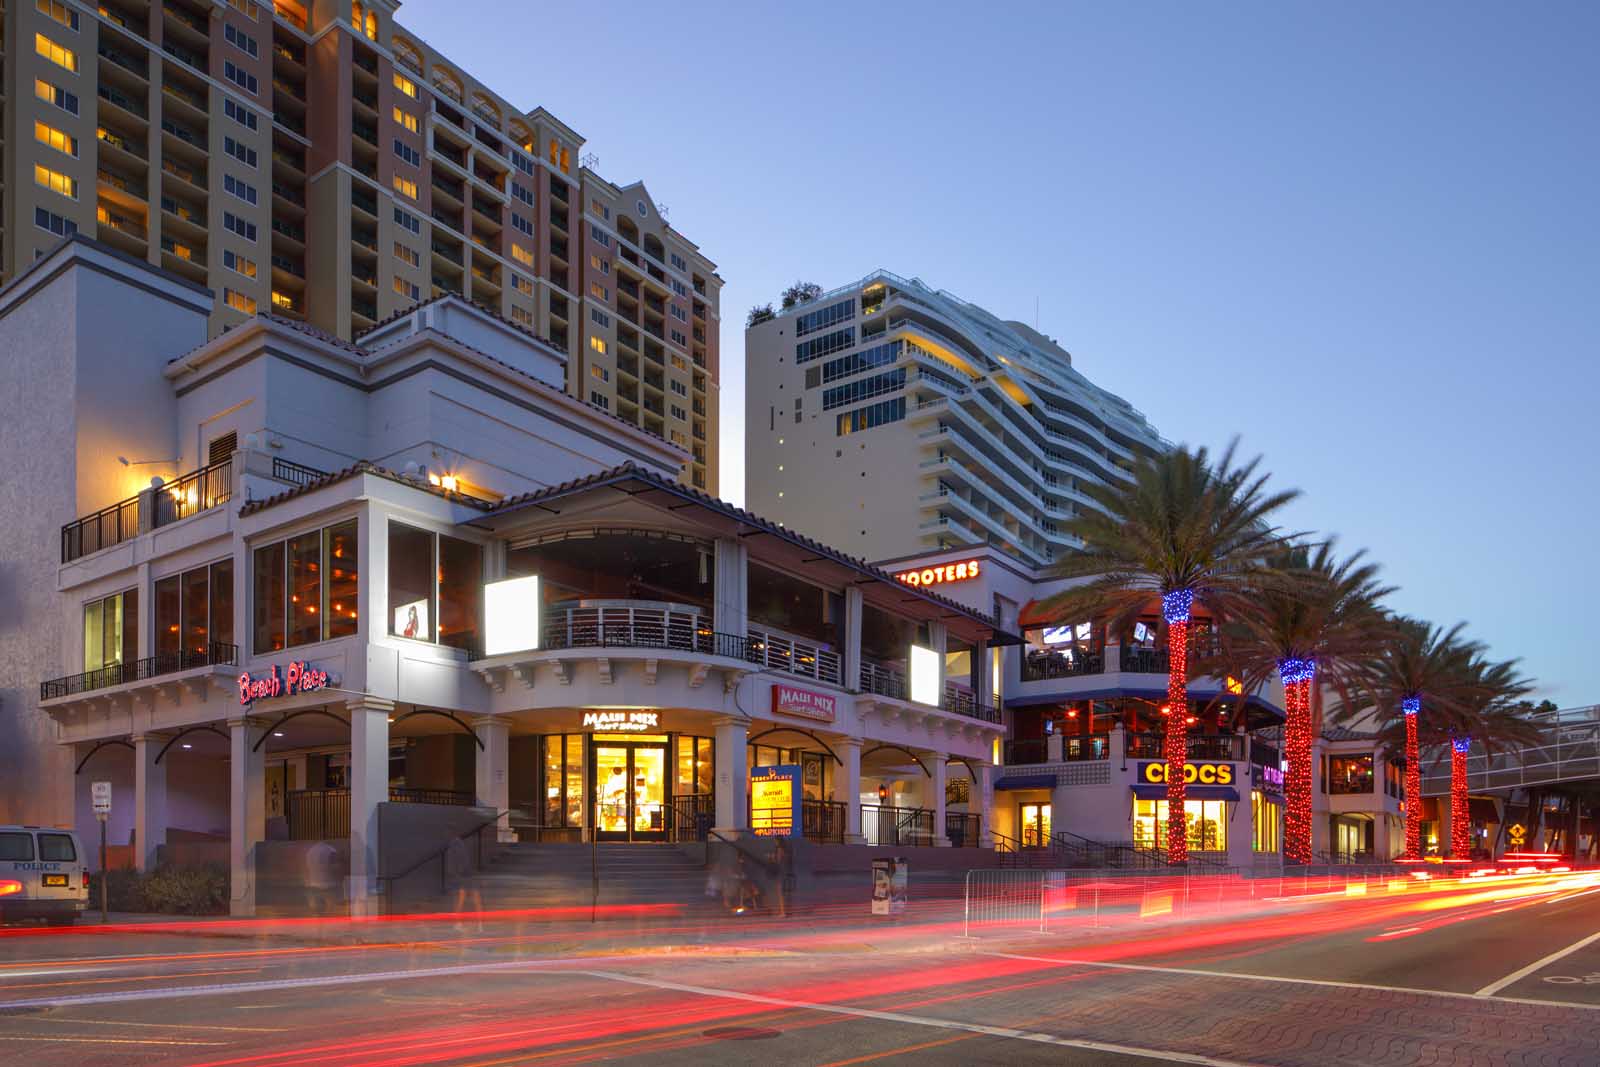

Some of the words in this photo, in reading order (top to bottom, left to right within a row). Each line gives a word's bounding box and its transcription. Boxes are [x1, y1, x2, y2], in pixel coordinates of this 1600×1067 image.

[895, 560, 979, 586] OOTERS
[239, 664, 281, 705] Beach
[287, 661, 328, 695] Place
[780, 688, 810, 705] MAUI
[814, 695, 833, 714] NIX
[583, 712, 625, 727] MAUI
[629, 712, 659, 727] NIX
[1145, 762, 1231, 784] COCS
[14, 862, 60, 872] POLICE
